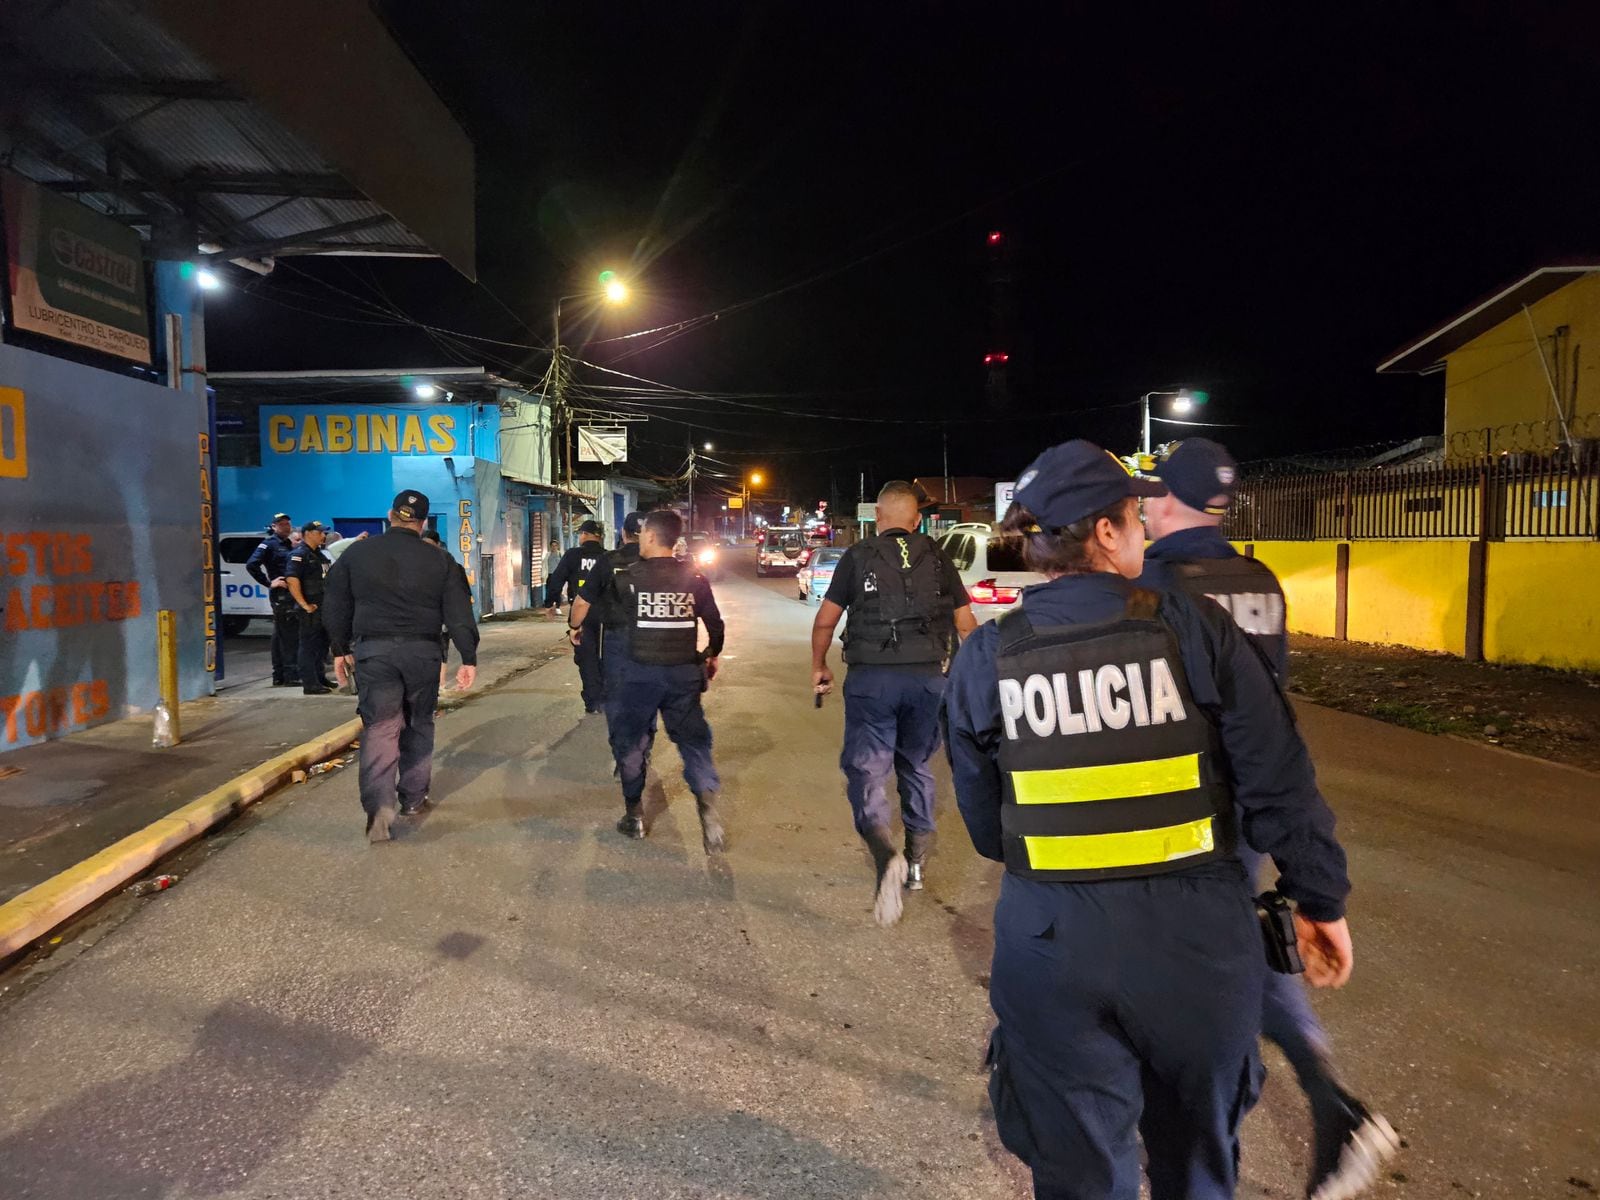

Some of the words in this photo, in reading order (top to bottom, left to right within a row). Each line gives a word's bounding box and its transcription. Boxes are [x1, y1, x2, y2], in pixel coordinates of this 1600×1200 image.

[28, 306, 94, 335] LUBRICENTRO
[96, 325, 107, 339] EL
[108, 328, 147, 350] PARQUEO
[268, 414, 457, 454] CABINAS
[0, 531, 94, 577] STOS
[458, 499, 476, 605] CABIN
[4, 580, 142, 632] ACEITES
[637, 592, 696, 605] FUERZA
[637, 605, 695, 618] PUBLICA
[999, 657, 1187, 740] POLICIA
